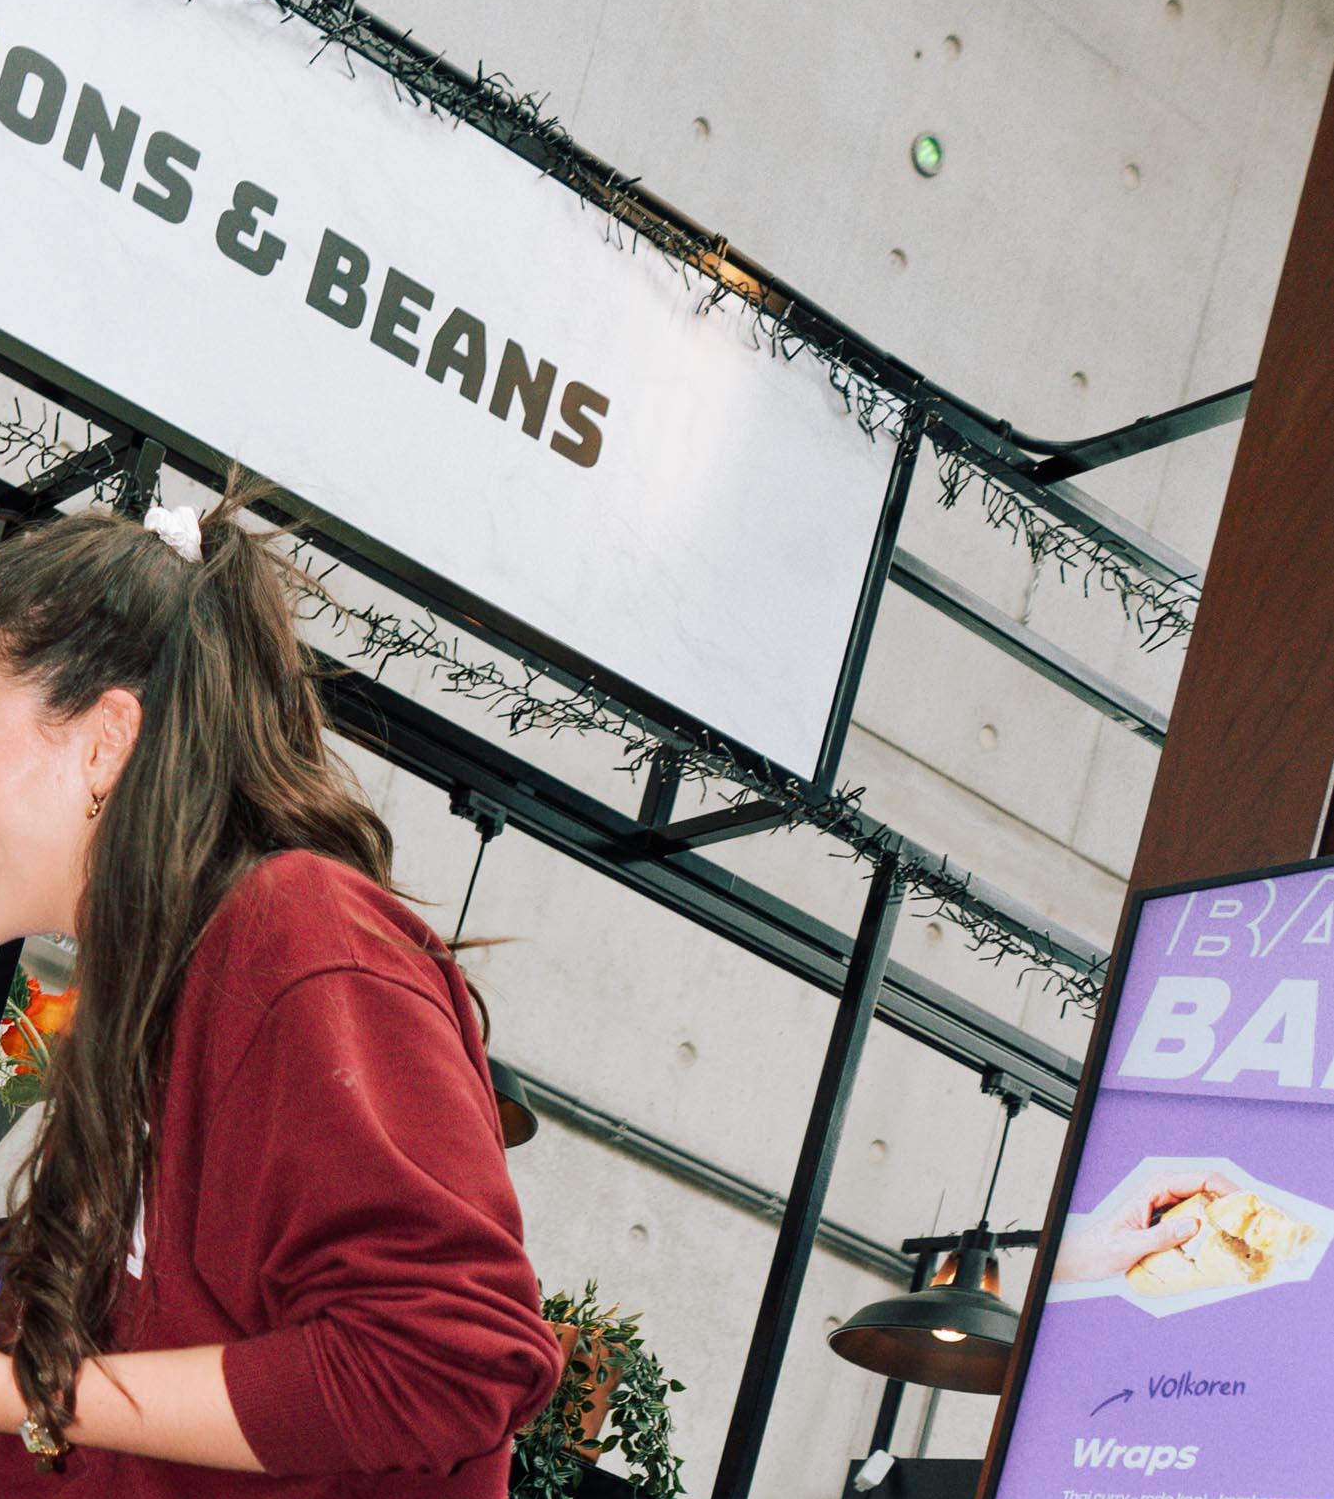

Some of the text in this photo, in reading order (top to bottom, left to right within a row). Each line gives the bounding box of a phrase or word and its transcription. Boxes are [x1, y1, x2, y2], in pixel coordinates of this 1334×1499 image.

[215, 180, 285, 277] &
[305, 228, 611, 469] BEANS
[1117, 975, 1334, 1089] BA
[1148, 1370, 1246, 1400] Volkoren
[1073, 1437, 1201, 1477] Wraps
